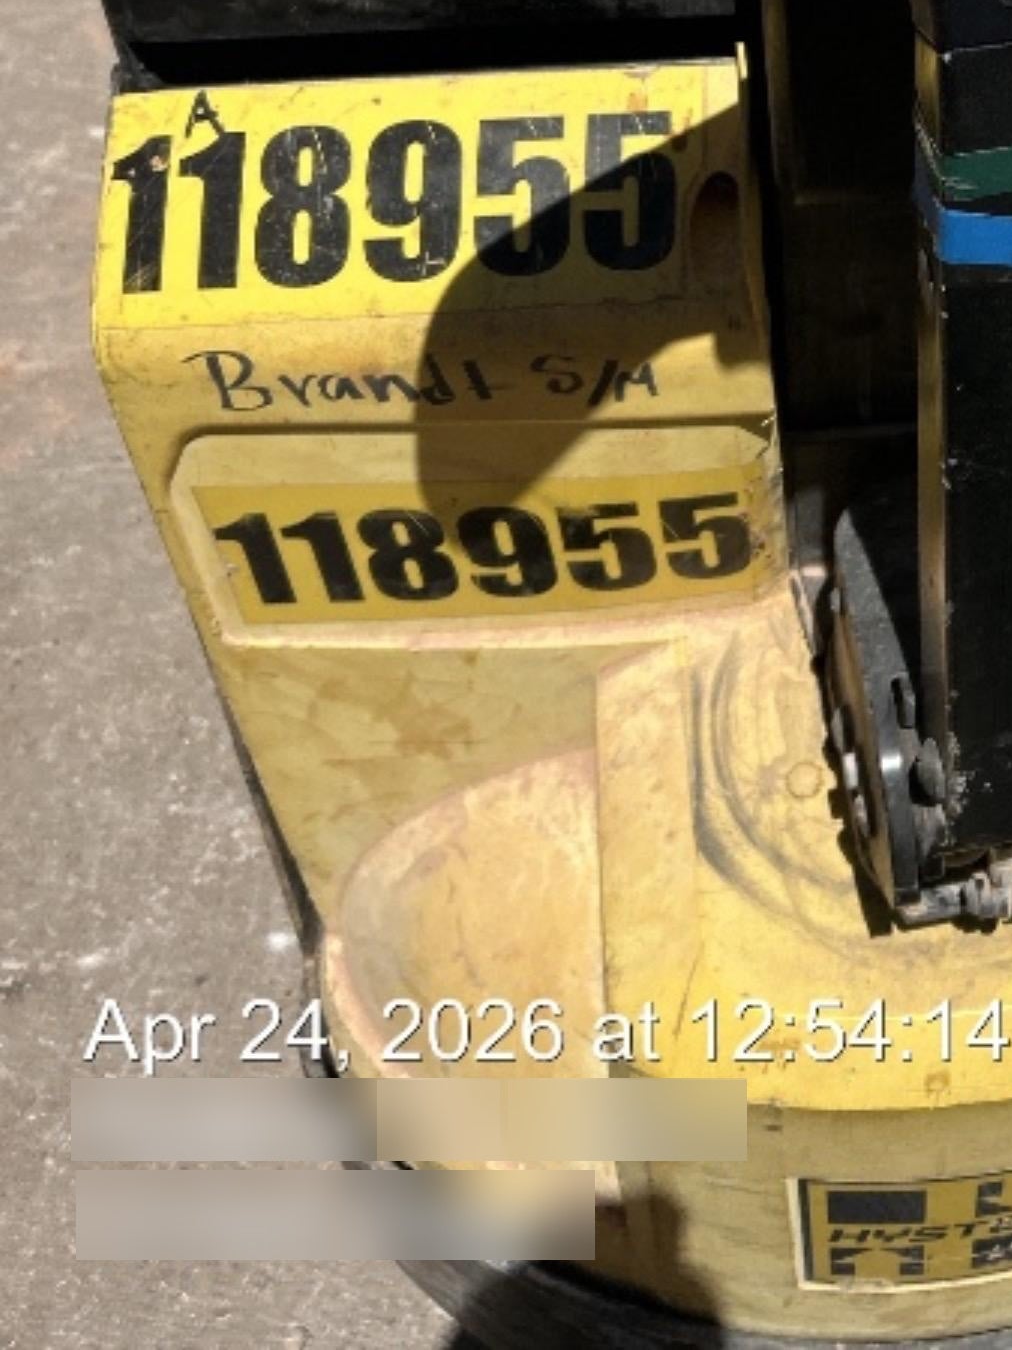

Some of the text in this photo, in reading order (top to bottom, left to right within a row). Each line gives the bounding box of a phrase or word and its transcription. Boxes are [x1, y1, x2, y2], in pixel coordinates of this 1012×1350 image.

[184, 90, 224, 138] A
[111, 112, 677, 295] 118955
[214, 493, 753, 605] 118955
